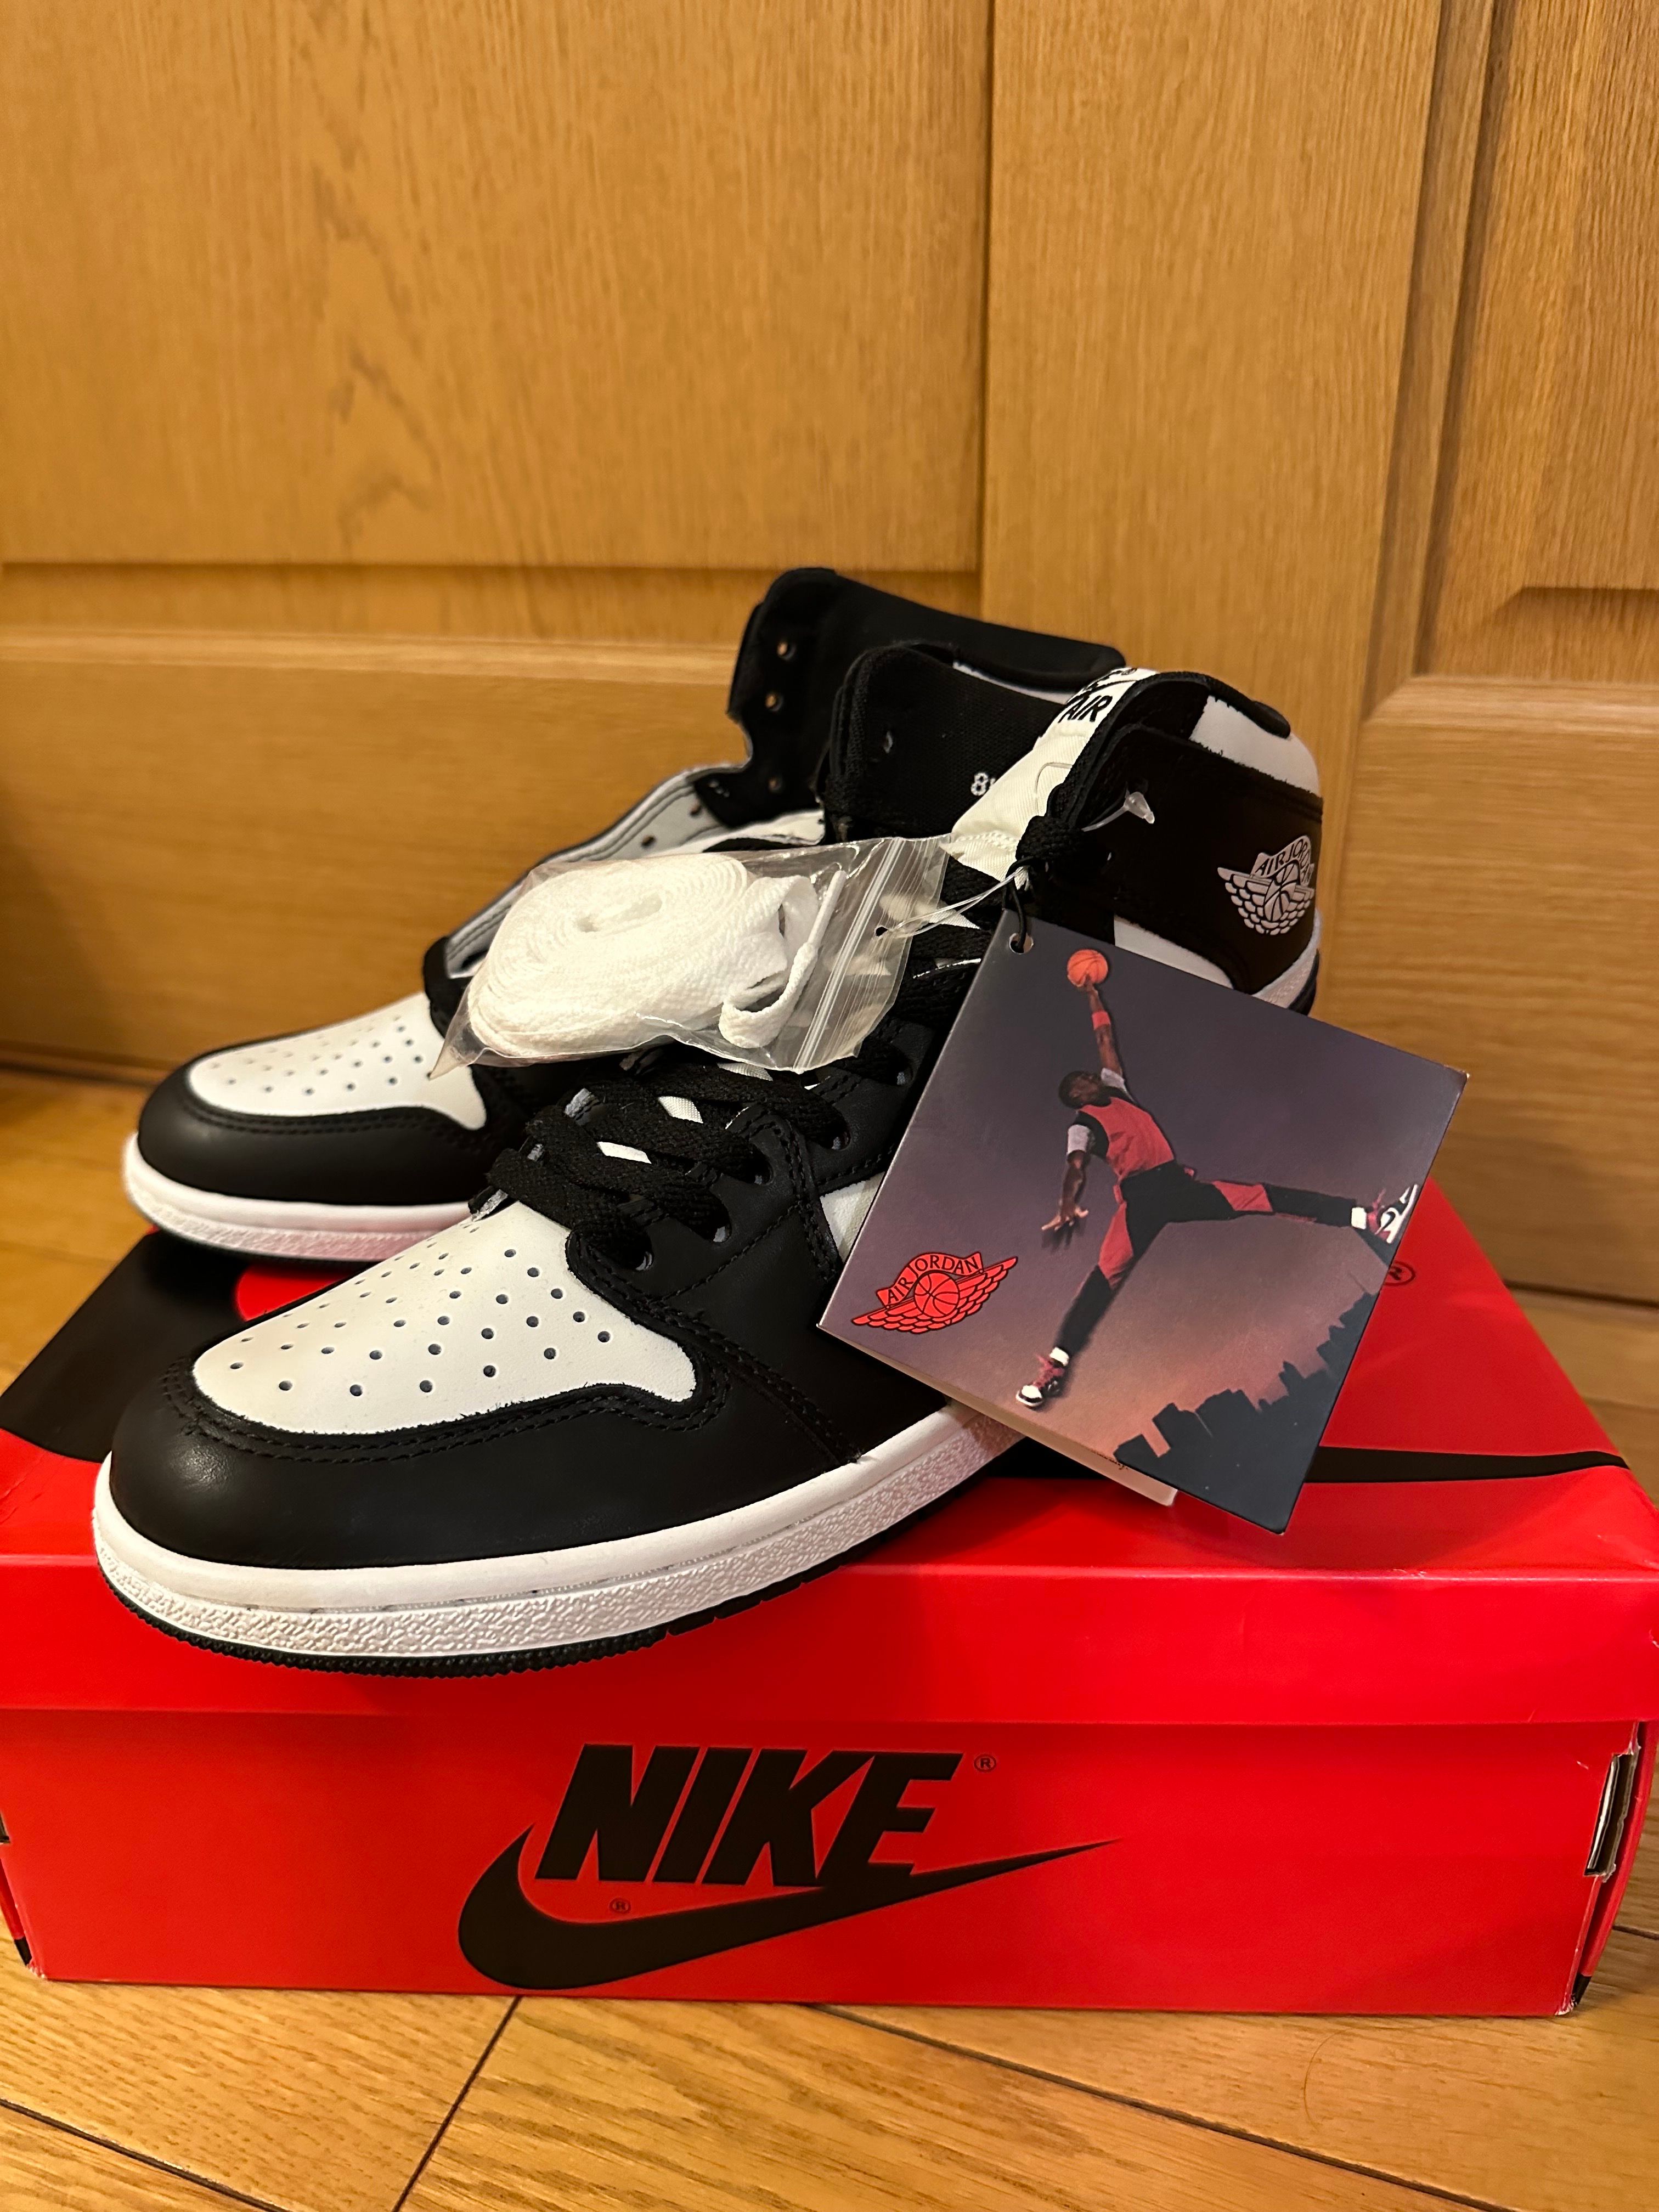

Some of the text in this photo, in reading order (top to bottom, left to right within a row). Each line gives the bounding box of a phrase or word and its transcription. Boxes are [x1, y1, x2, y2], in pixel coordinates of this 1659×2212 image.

[1058, 695, 1113, 723] AIR
[970, 772, 997, 796] 8
[1255, 851, 1285, 876] AIR
[888, 1255, 979, 1304] AIR JORDAN
[534, 1743, 964, 1887] NIKE
